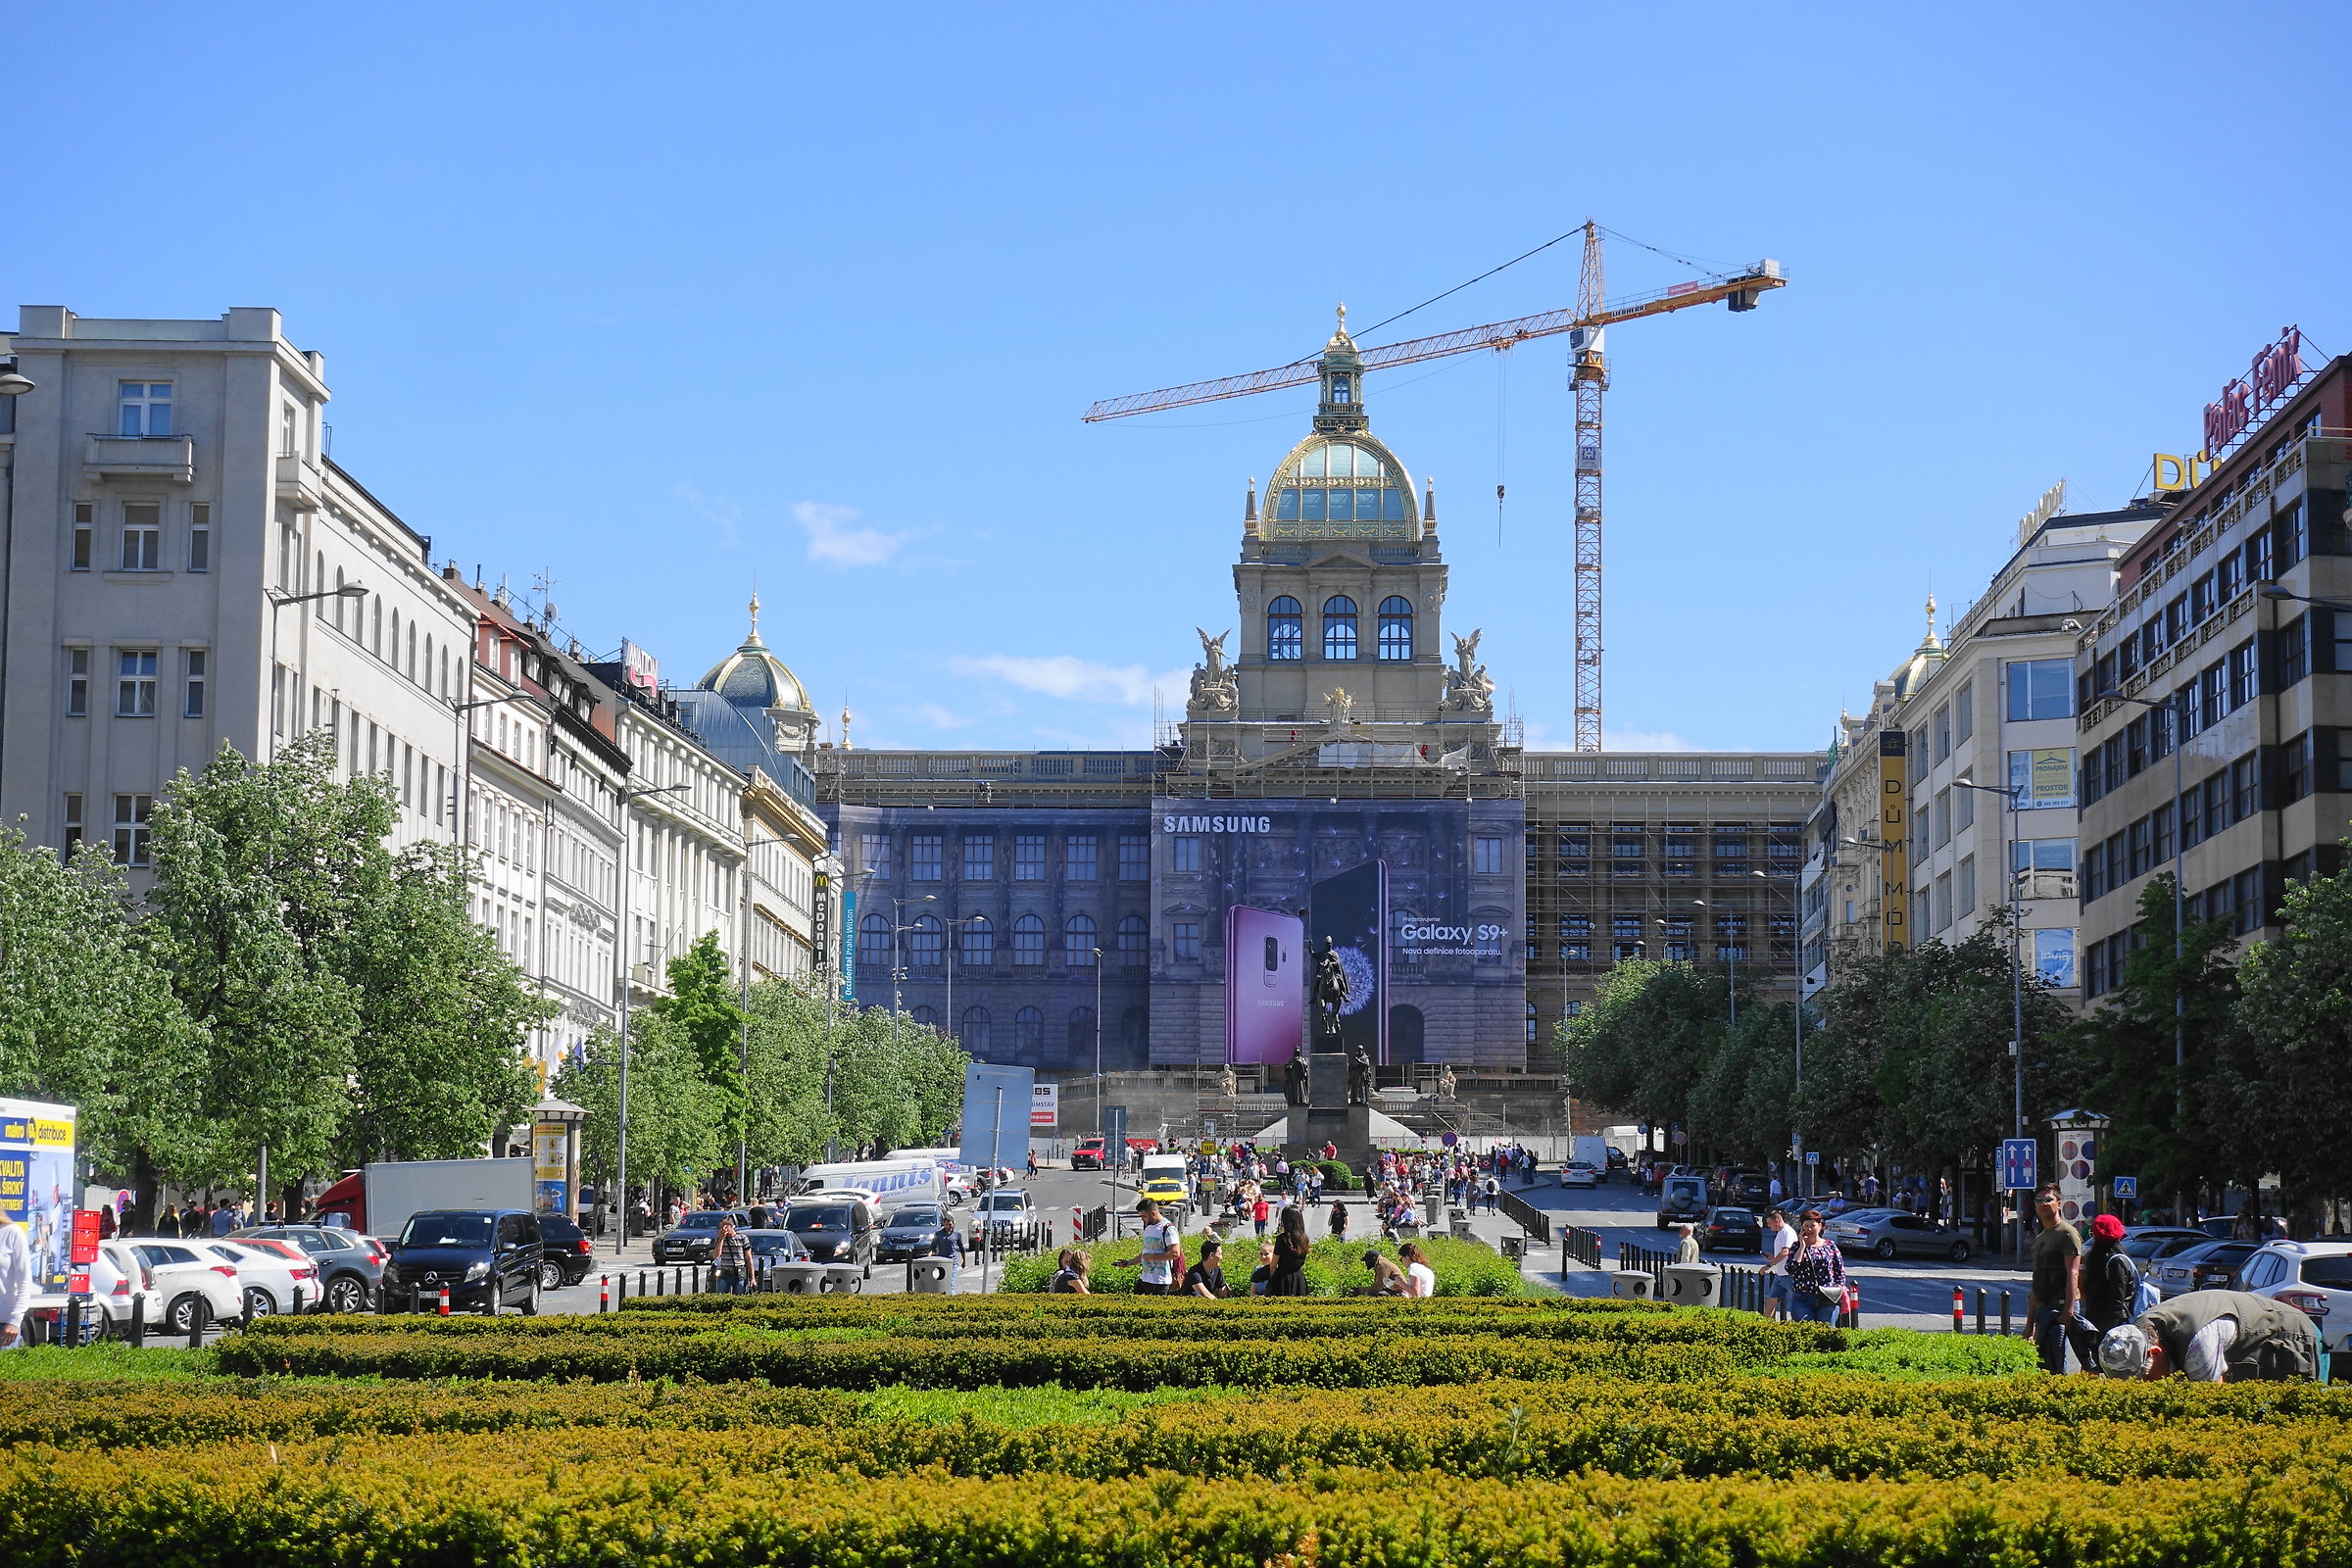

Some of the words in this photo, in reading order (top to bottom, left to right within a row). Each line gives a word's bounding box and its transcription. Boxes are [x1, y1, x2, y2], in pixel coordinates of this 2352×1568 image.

[1612, 305, 1644, 318] LIEBHERR
[2204, 378, 2250, 464] Palác
[2252, 326, 2303, 416] Fénix
[1163, 815, 1270, 833] SAMSUNG
[1885, 779, 1902, 854] DŮM
[1400, 923, 1473, 946] Galaxy
[1477, 924, 1508, 941] S9+
[845, 934, 854, 956] Praha
[1402, 947, 1422, 956] Nová
[1423, 947, 1454, 956] definice
[1455, 947, 1502, 957] fotoaparátu.
[2040, 950, 2070, 961] invia
[1256, 999, 1285, 1007] SAMSUNG
[5, 1120, 24, 1139] makro
[38, 1124, 66, 1142] distribuce
[3, 1198, 24, 1211] RTIMENT
